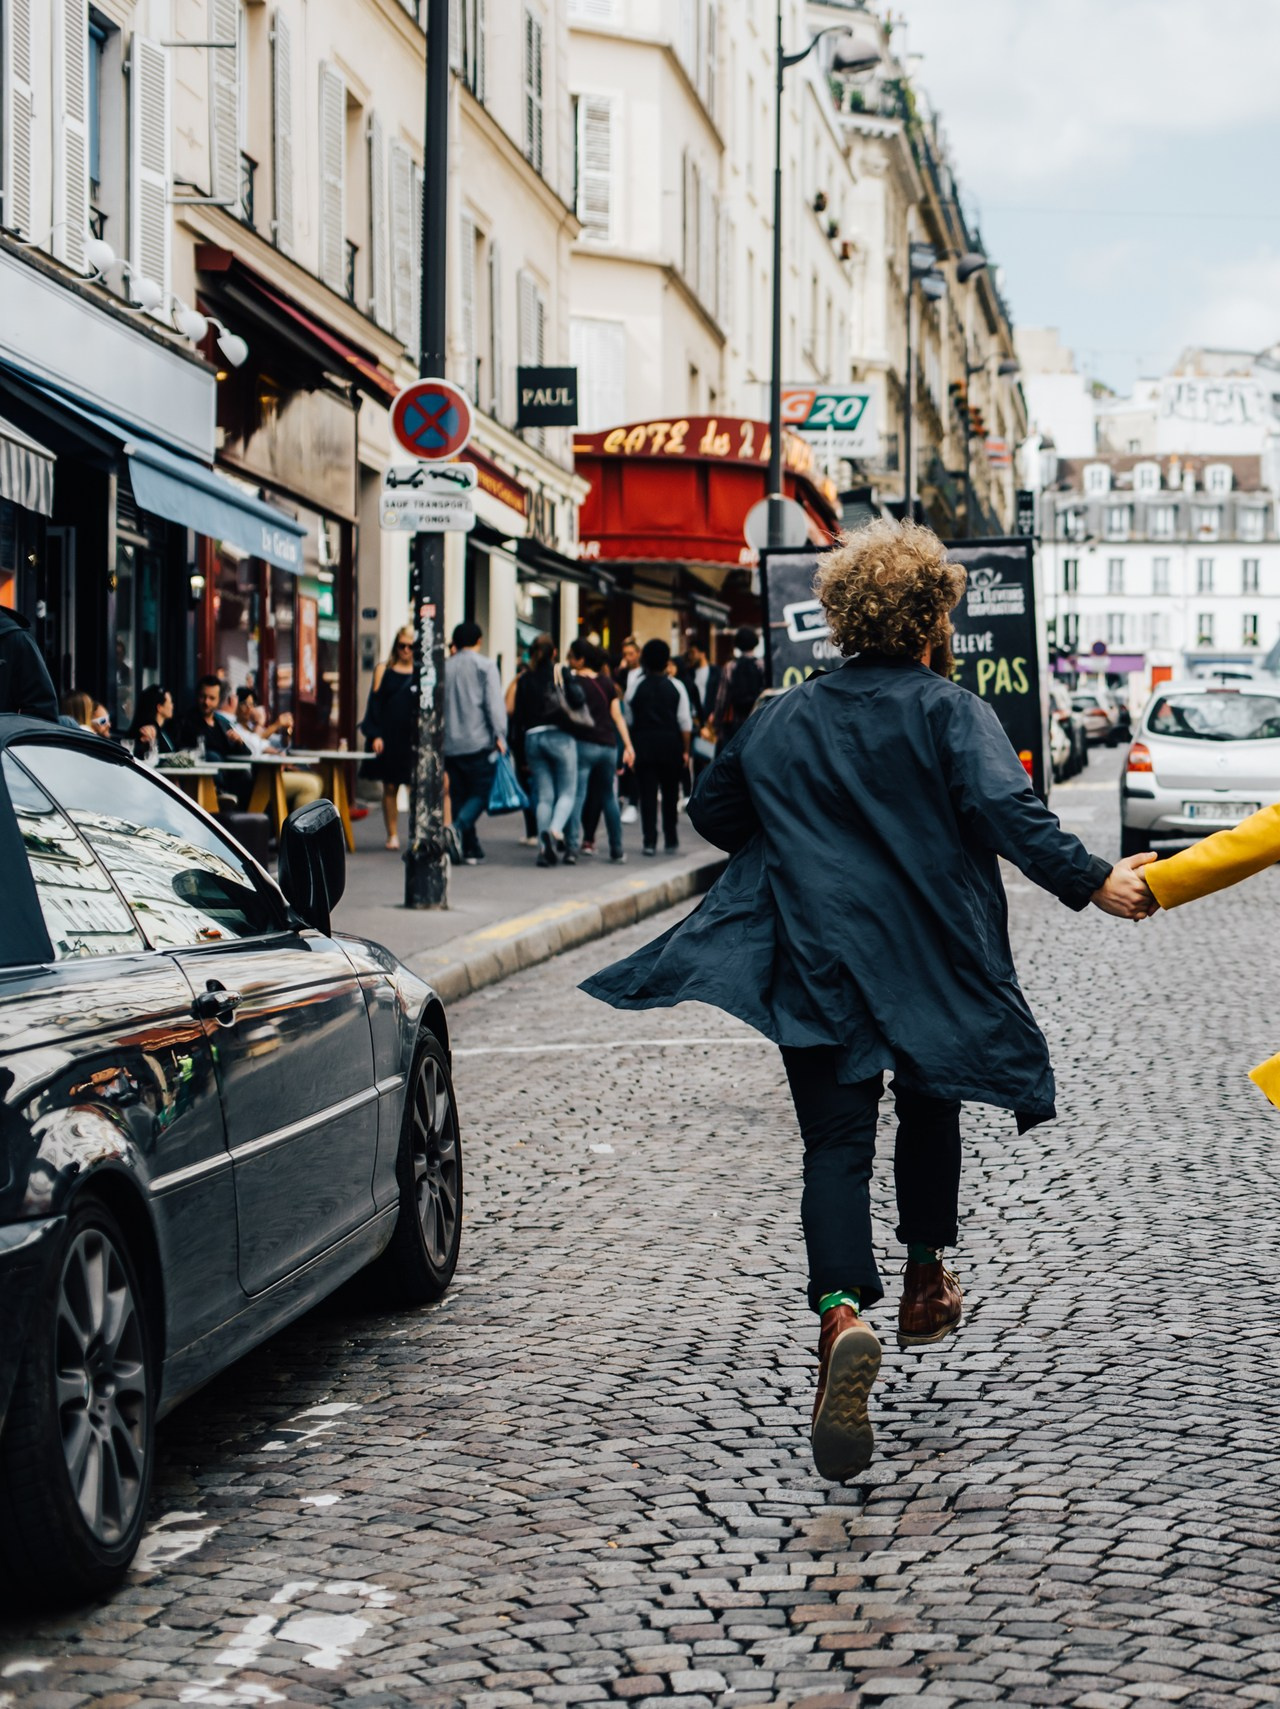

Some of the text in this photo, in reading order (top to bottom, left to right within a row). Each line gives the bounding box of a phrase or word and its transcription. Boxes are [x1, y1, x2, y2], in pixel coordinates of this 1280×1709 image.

[522, 387, 574, 406] PAUL
[781, 393, 864, 424] G20
[698, 420, 731, 456] des
[738, 421, 755, 459] 2
[384, 501, 469, 509] SAUF TRANSPORT
[419, 515, 451, 523] FONDS
[977, 657, 1029, 696] PAS
